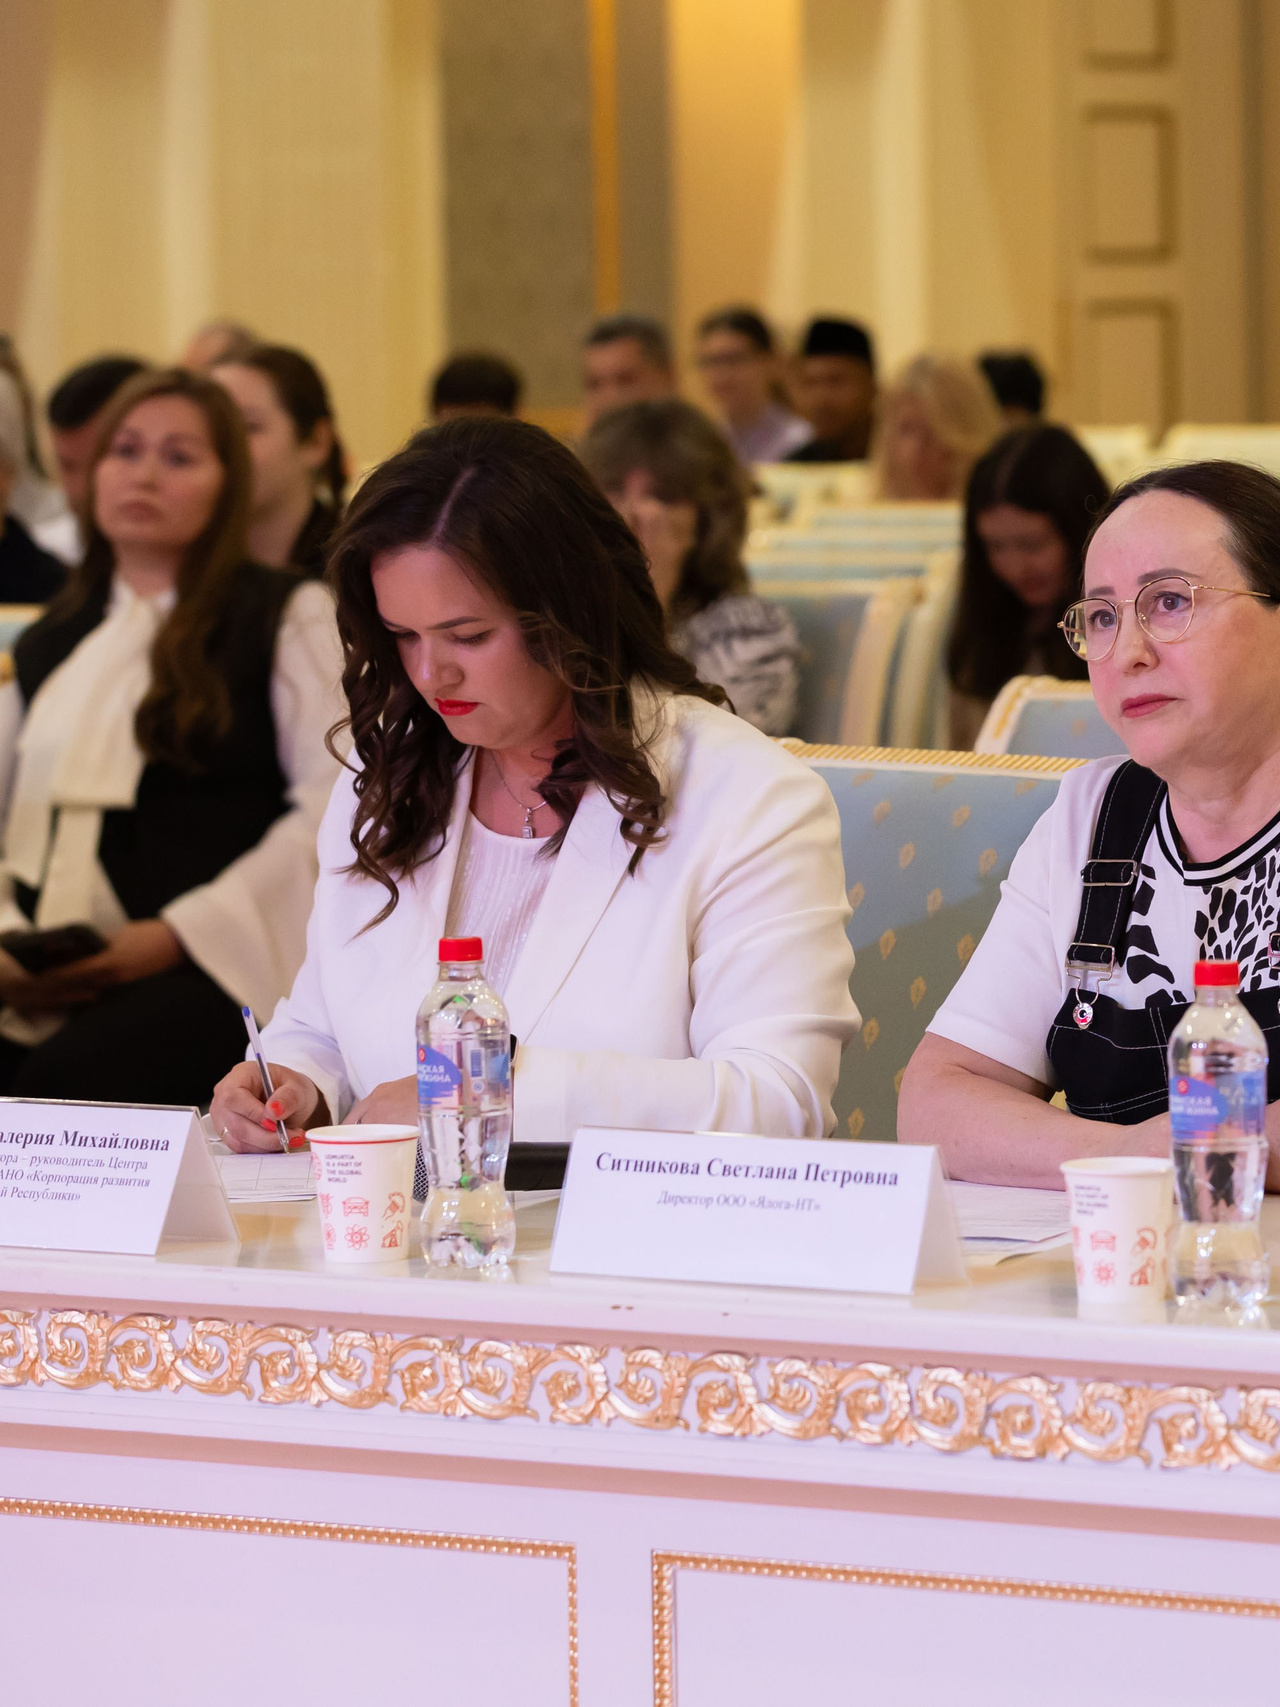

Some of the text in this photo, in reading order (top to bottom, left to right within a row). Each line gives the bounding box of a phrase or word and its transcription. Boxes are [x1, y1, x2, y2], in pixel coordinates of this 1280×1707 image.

[59, 1130, 170, 1151] Михайловна
[30, 1155, 105, 1168] руководитель
[108, 1156, 148, 1170] Центра
[596, 1151, 899, 1188] Ситникова Светлана Петровна
[26, 1170, 98, 1186] «Корпорация
[101, 1176, 150, 1188] развития
[11, 1186, 81, 1202] Республики»
[657, 1190, 713, 1209] Директор
[716, 1193, 747, 1207] ООО
